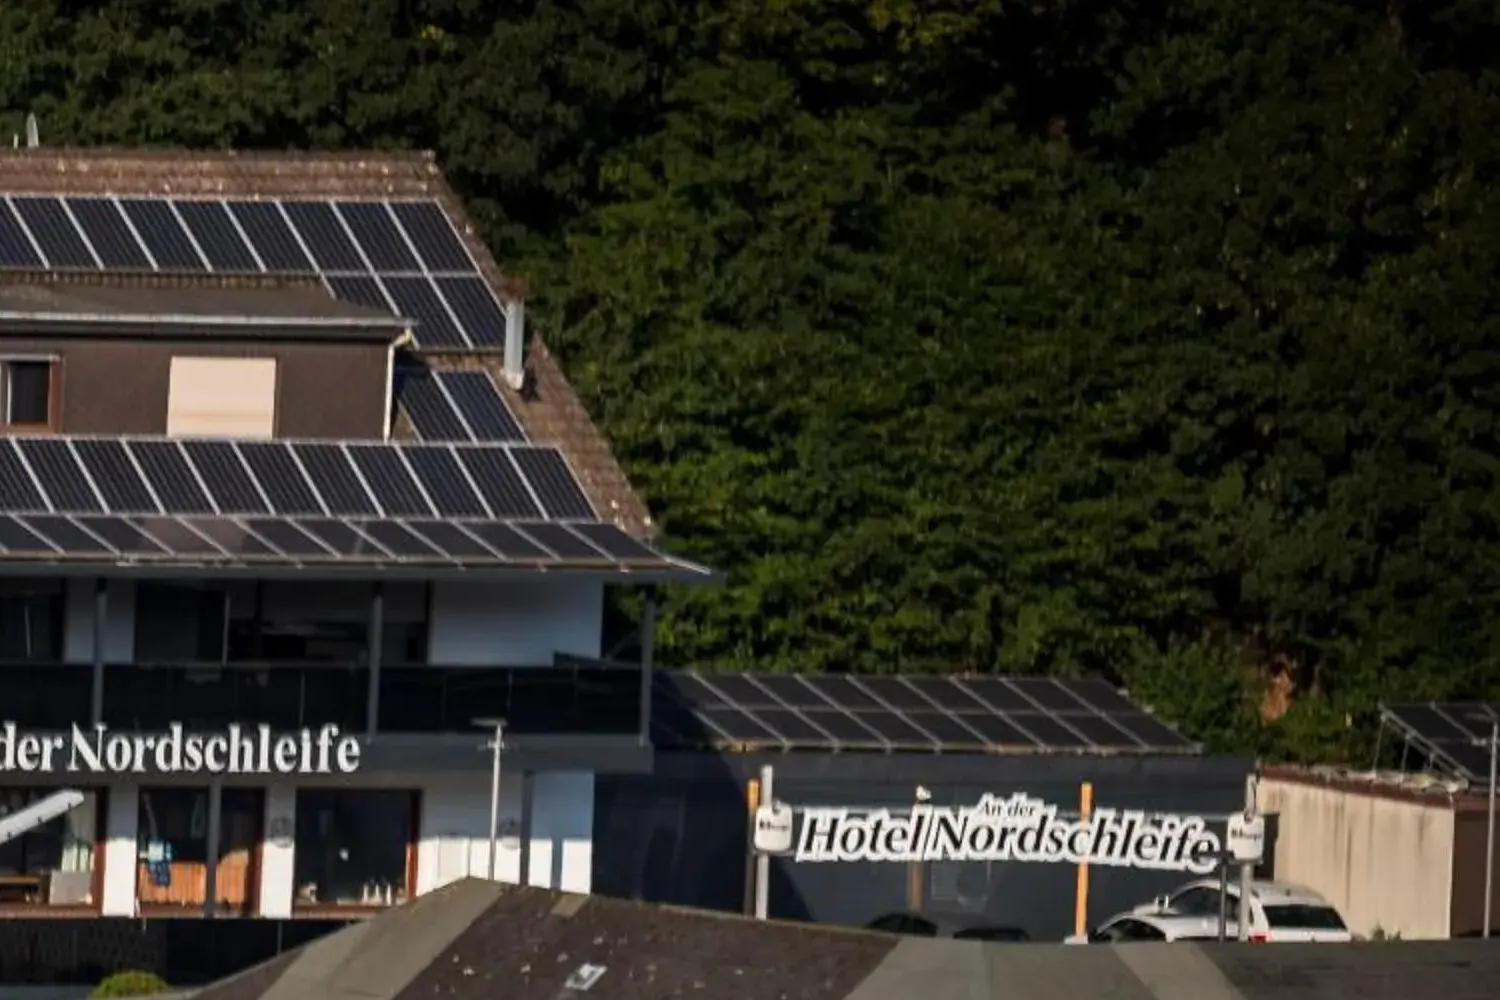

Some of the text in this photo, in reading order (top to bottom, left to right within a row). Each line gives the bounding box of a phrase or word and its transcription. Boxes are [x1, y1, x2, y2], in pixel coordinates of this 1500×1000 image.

[66, 722, 361, 774] Nordschleife
[802, 811, 1217, 869] Hotel Nordschleife
